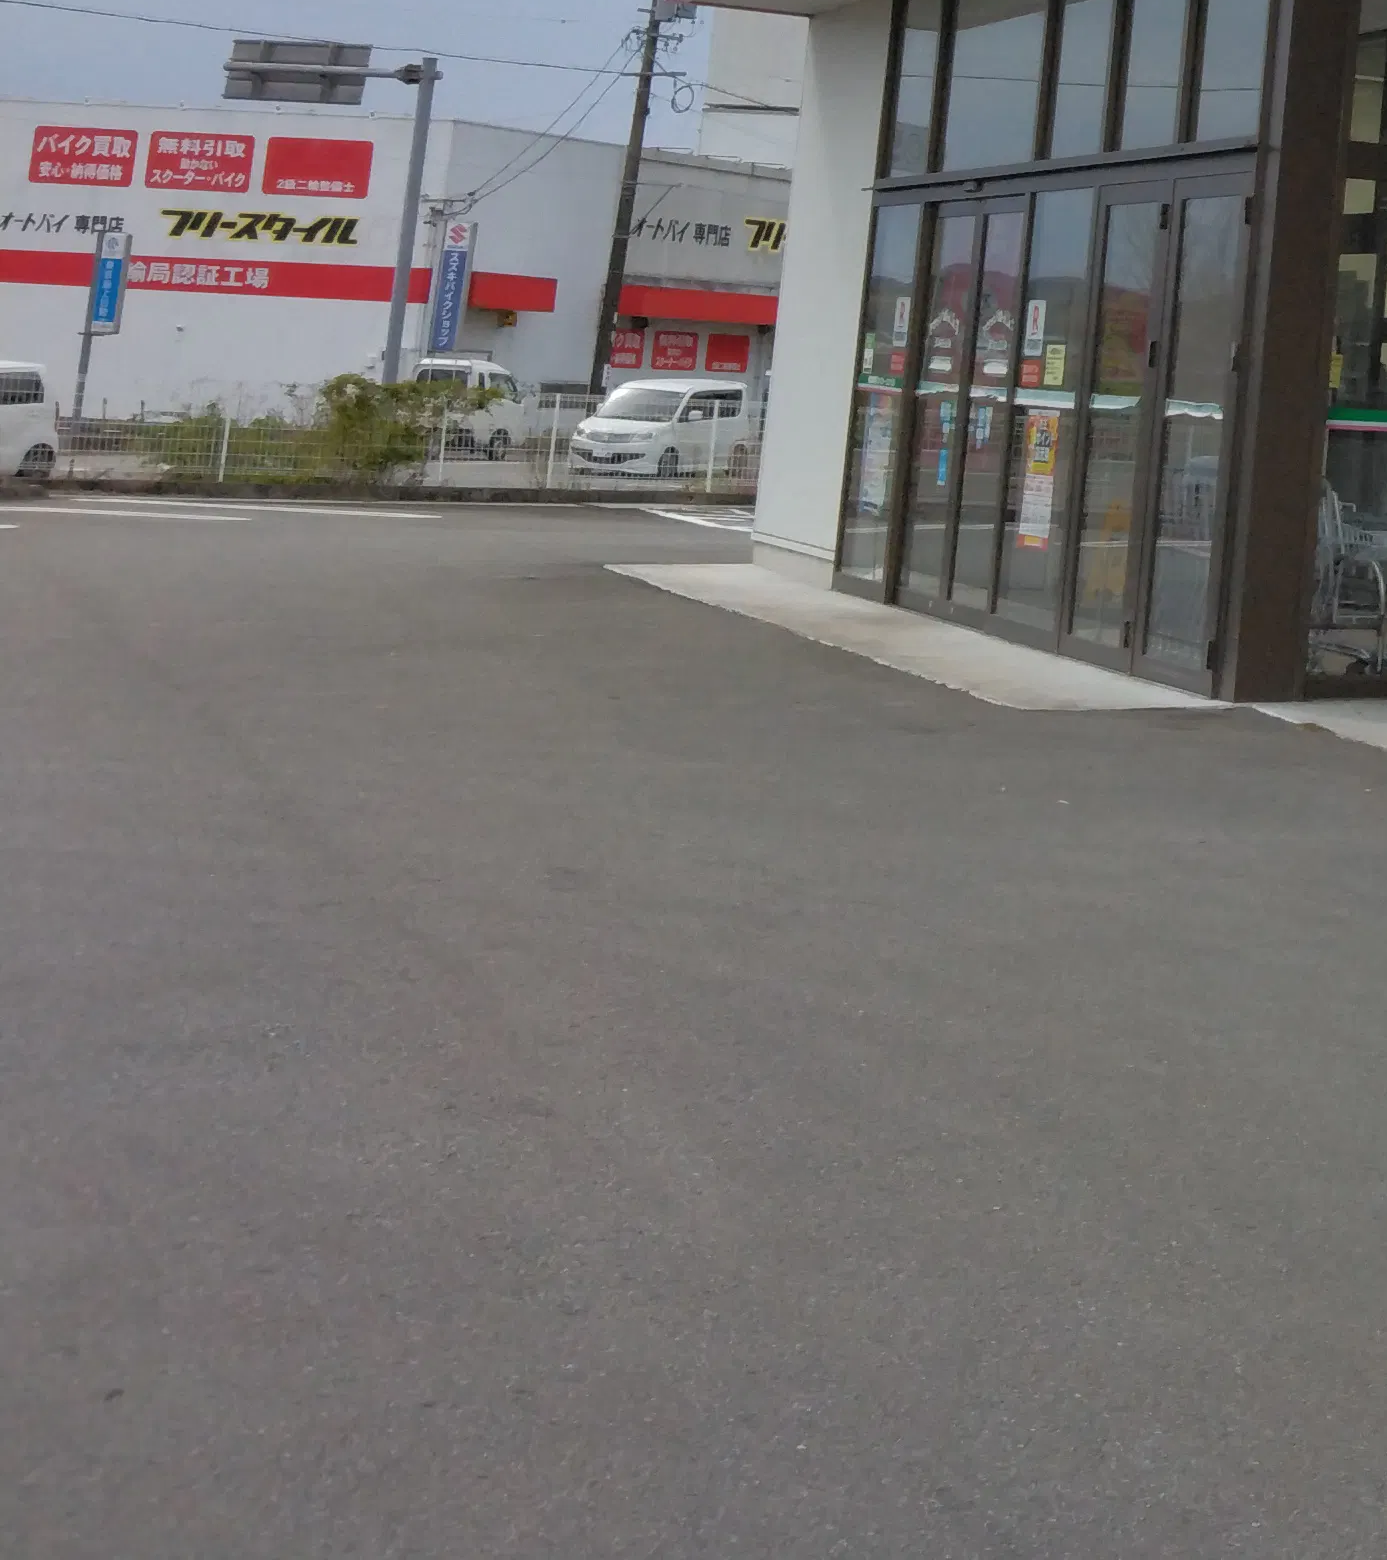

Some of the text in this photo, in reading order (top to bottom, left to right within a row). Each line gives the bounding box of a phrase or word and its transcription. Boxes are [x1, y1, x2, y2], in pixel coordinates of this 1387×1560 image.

[37, 133, 132, 158] バイク買取
[157, 136, 247, 158] 無料引取
[0, 211, 125, 234] オートバイ 専門店
[161, 208, 361, 246] フリースタイル
[631, 218, 732, 247] オートバイ 専門店
